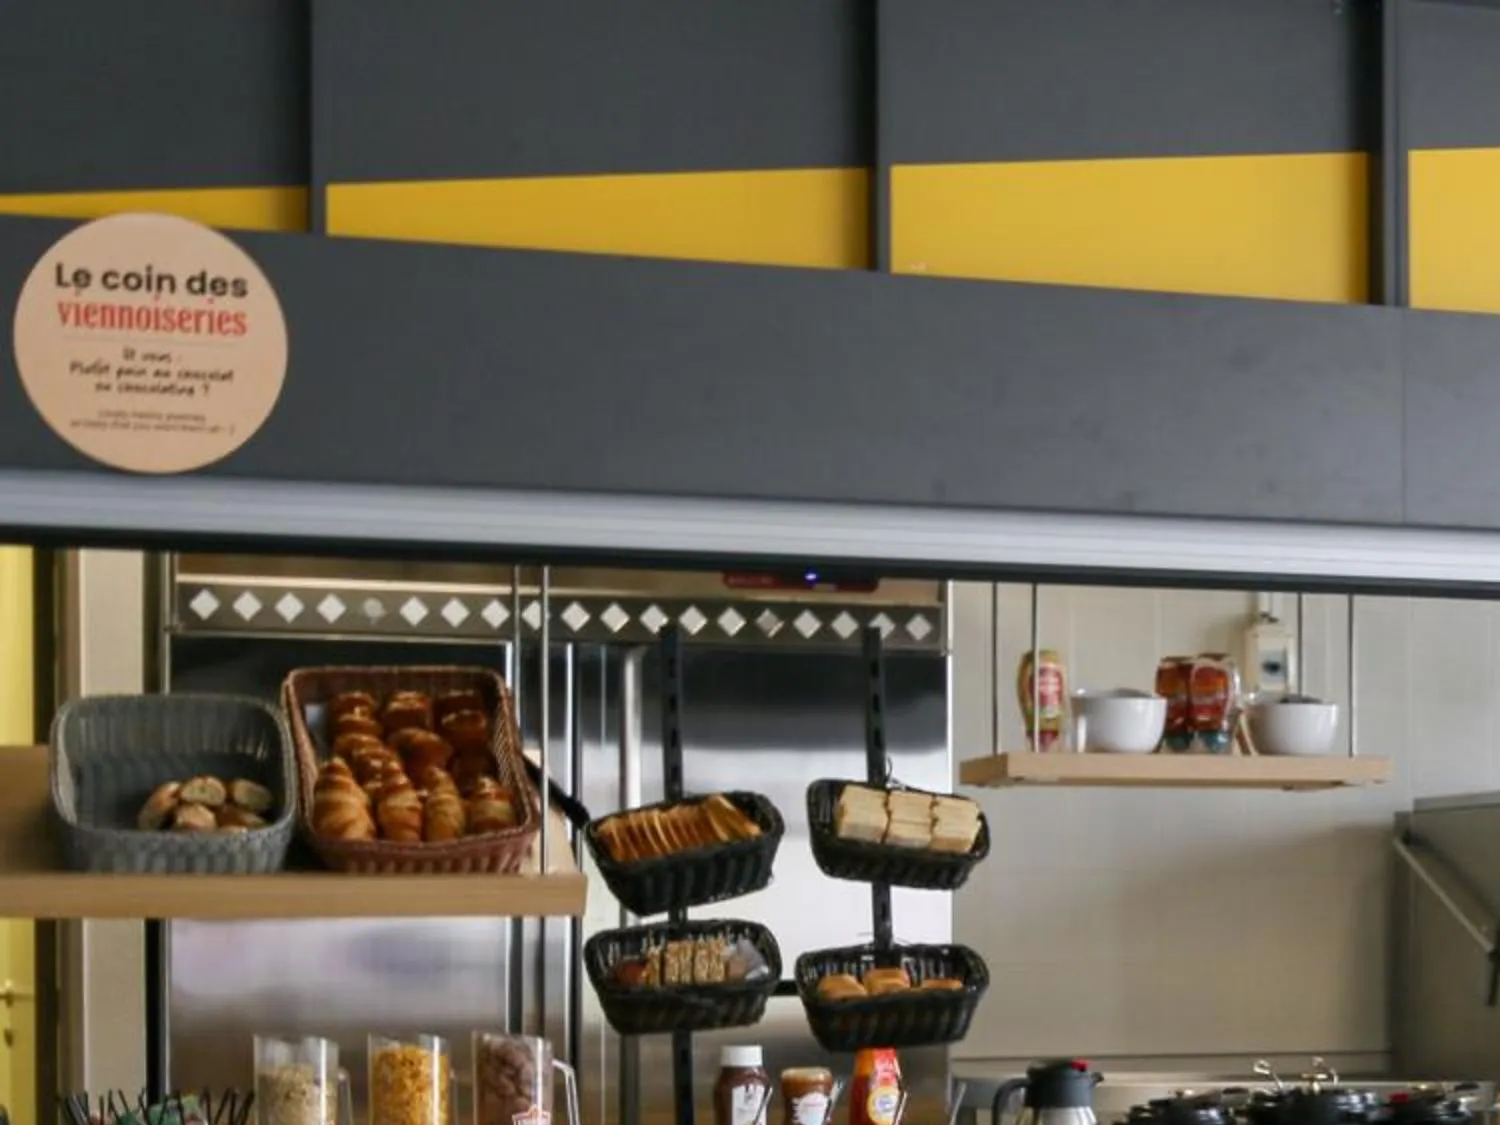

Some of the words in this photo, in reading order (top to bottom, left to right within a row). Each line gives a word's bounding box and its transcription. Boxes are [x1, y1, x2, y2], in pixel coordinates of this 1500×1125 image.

[55, 262, 92, 290] Le
[101, 264, 176, 295] coin
[186, 270, 249, 299] des
[56, 292, 248, 337] viennoiseries
